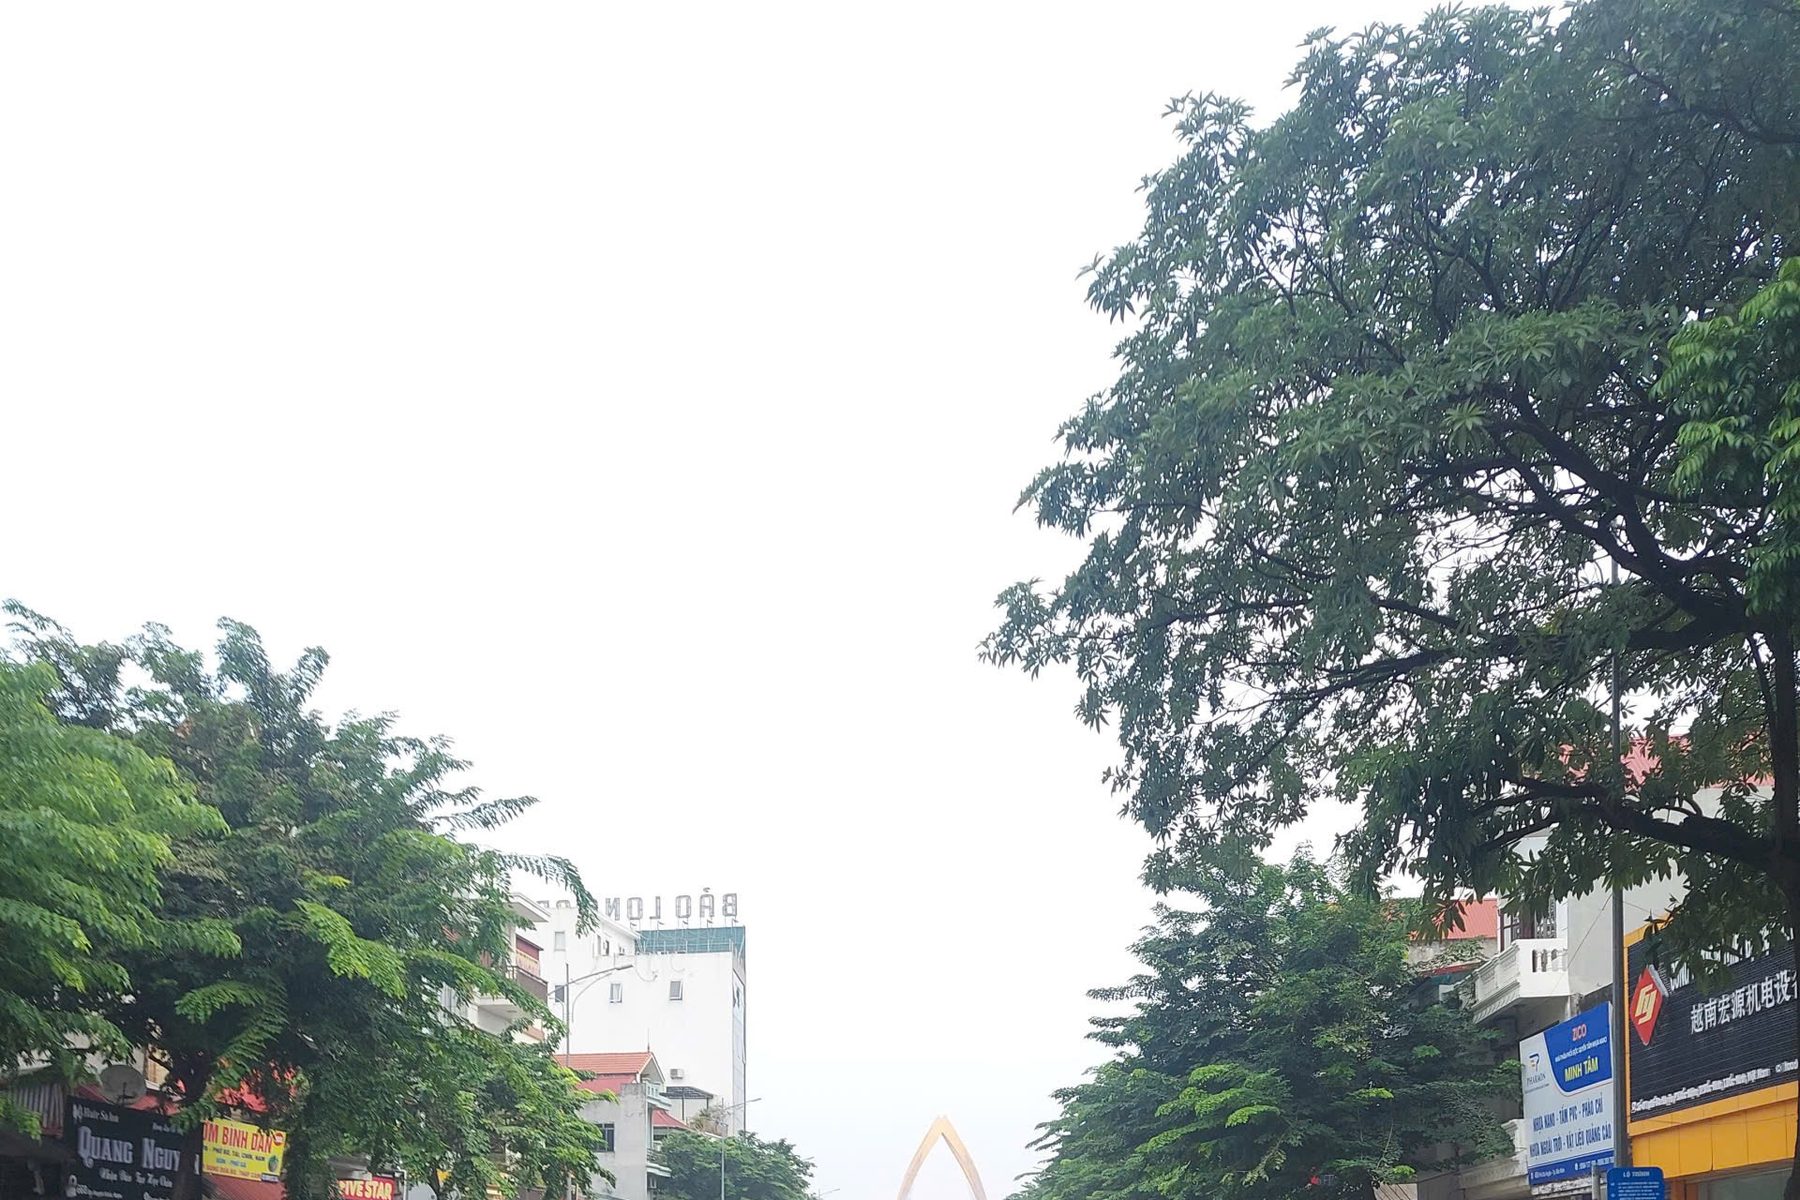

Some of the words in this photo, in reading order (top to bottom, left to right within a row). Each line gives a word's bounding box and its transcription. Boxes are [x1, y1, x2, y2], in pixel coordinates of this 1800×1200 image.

[1572, 1024, 1587, 1042] ZICO
[1565, 1062, 1583, 1082] MINH
[1583, 1056, 1599, 1075] TÂM
[1569, 1105, 1577, 1122] PVC
[203, 1121, 218, 1144] ƠM
[222, 1123, 248, 1149] BÌNH
[365, 1178, 393, 1200] STAR
